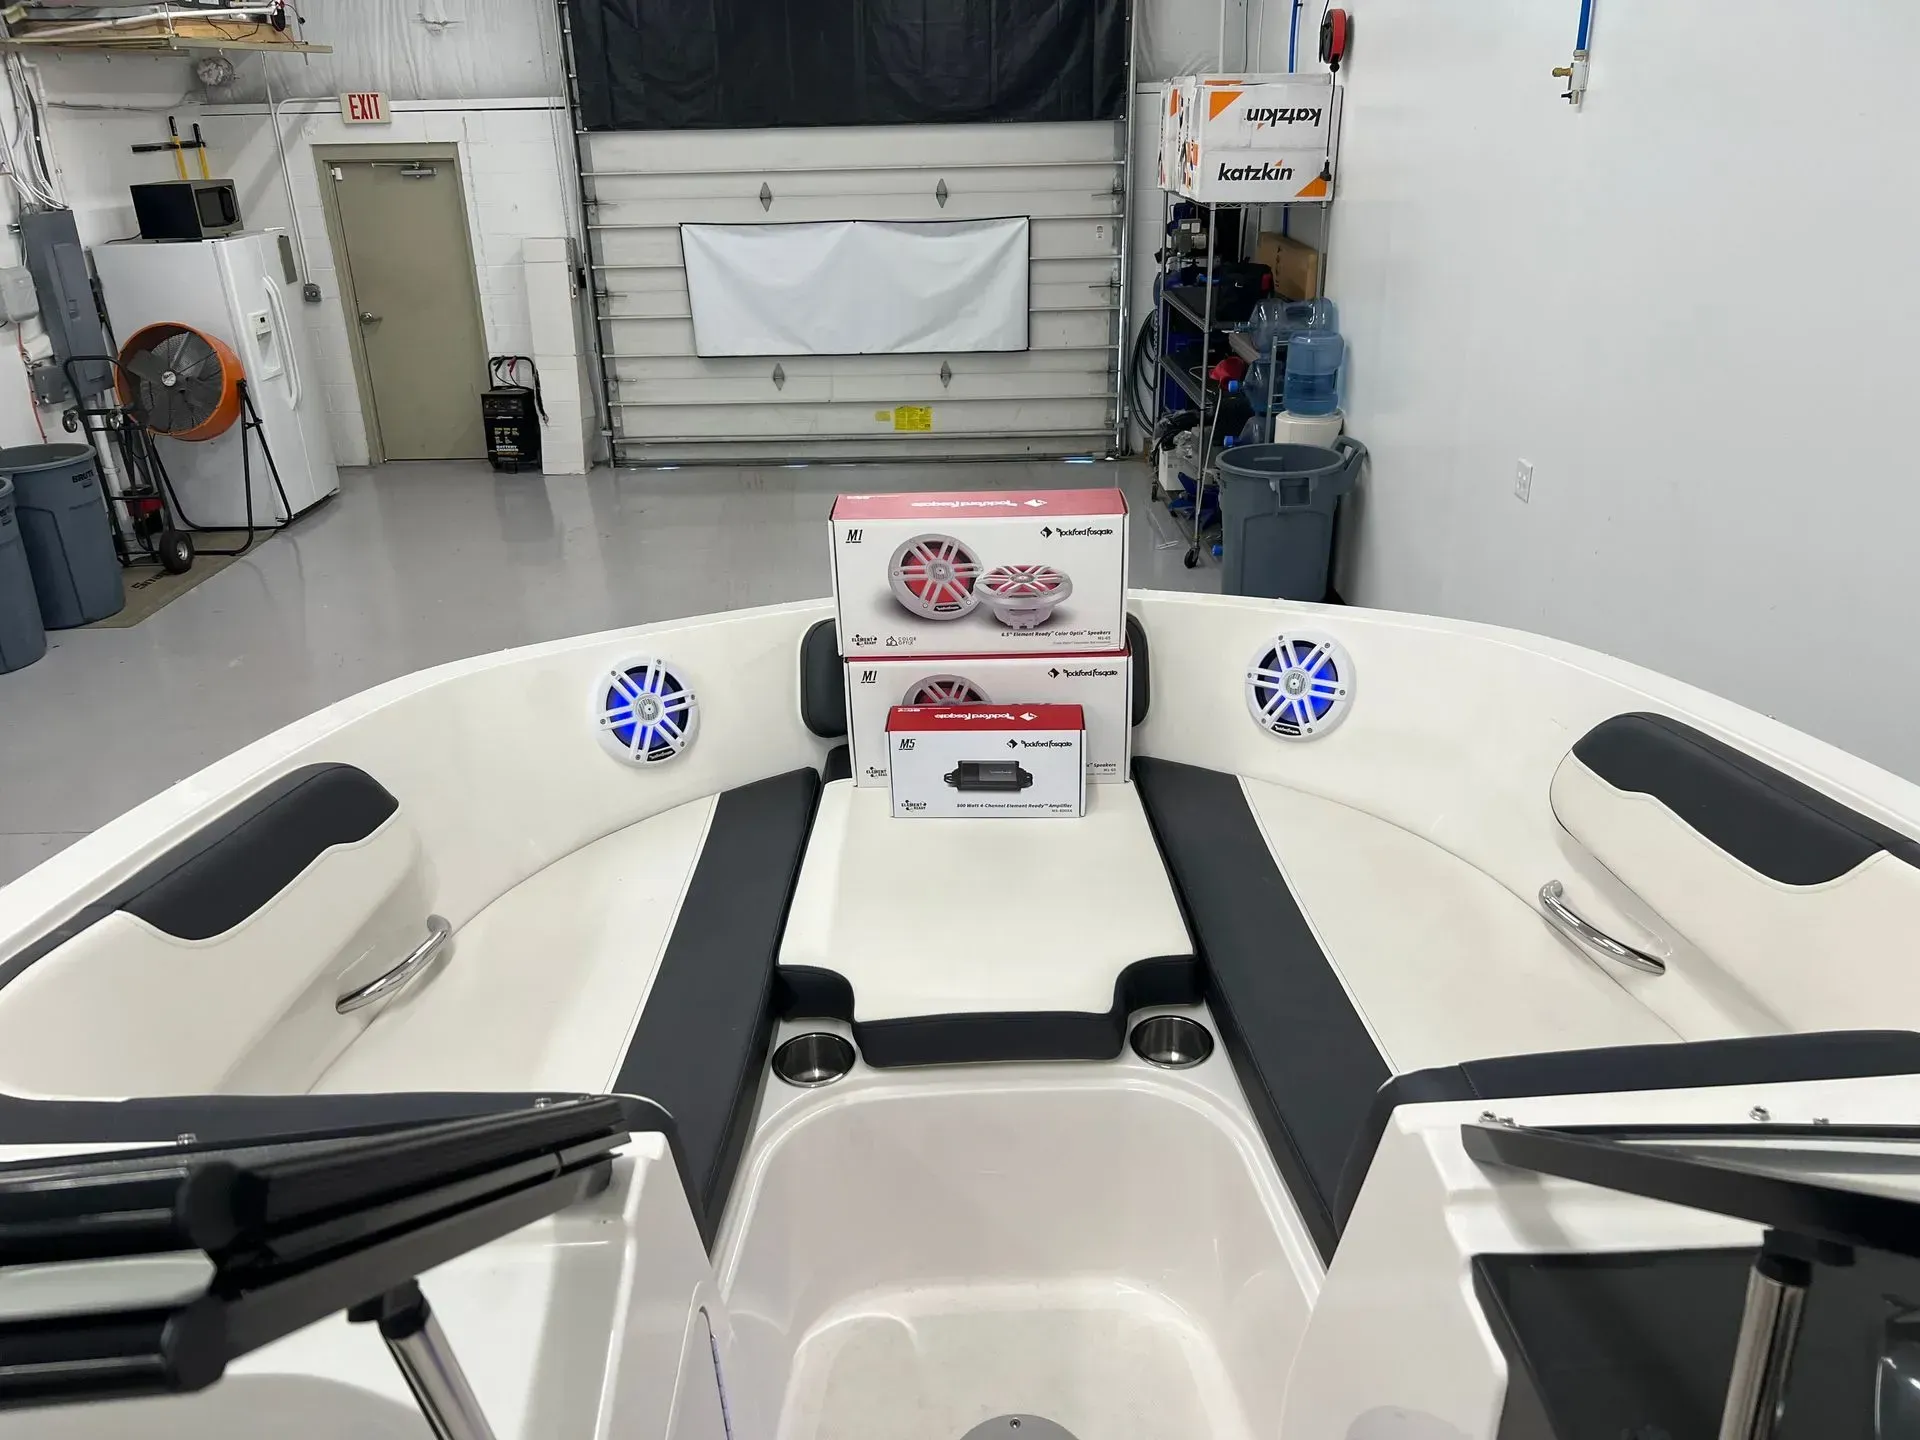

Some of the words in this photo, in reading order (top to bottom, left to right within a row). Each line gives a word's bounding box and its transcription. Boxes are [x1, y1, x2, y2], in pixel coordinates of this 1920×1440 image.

[347, 93, 381, 120] EXIT
[1246, 108, 1322, 130] katzkin
[1217, 159, 1293, 181] katzkin
[845, 529, 863, 543] M1
[860, 670, 878, 683] M1
[898, 738, 916, 750] M5
